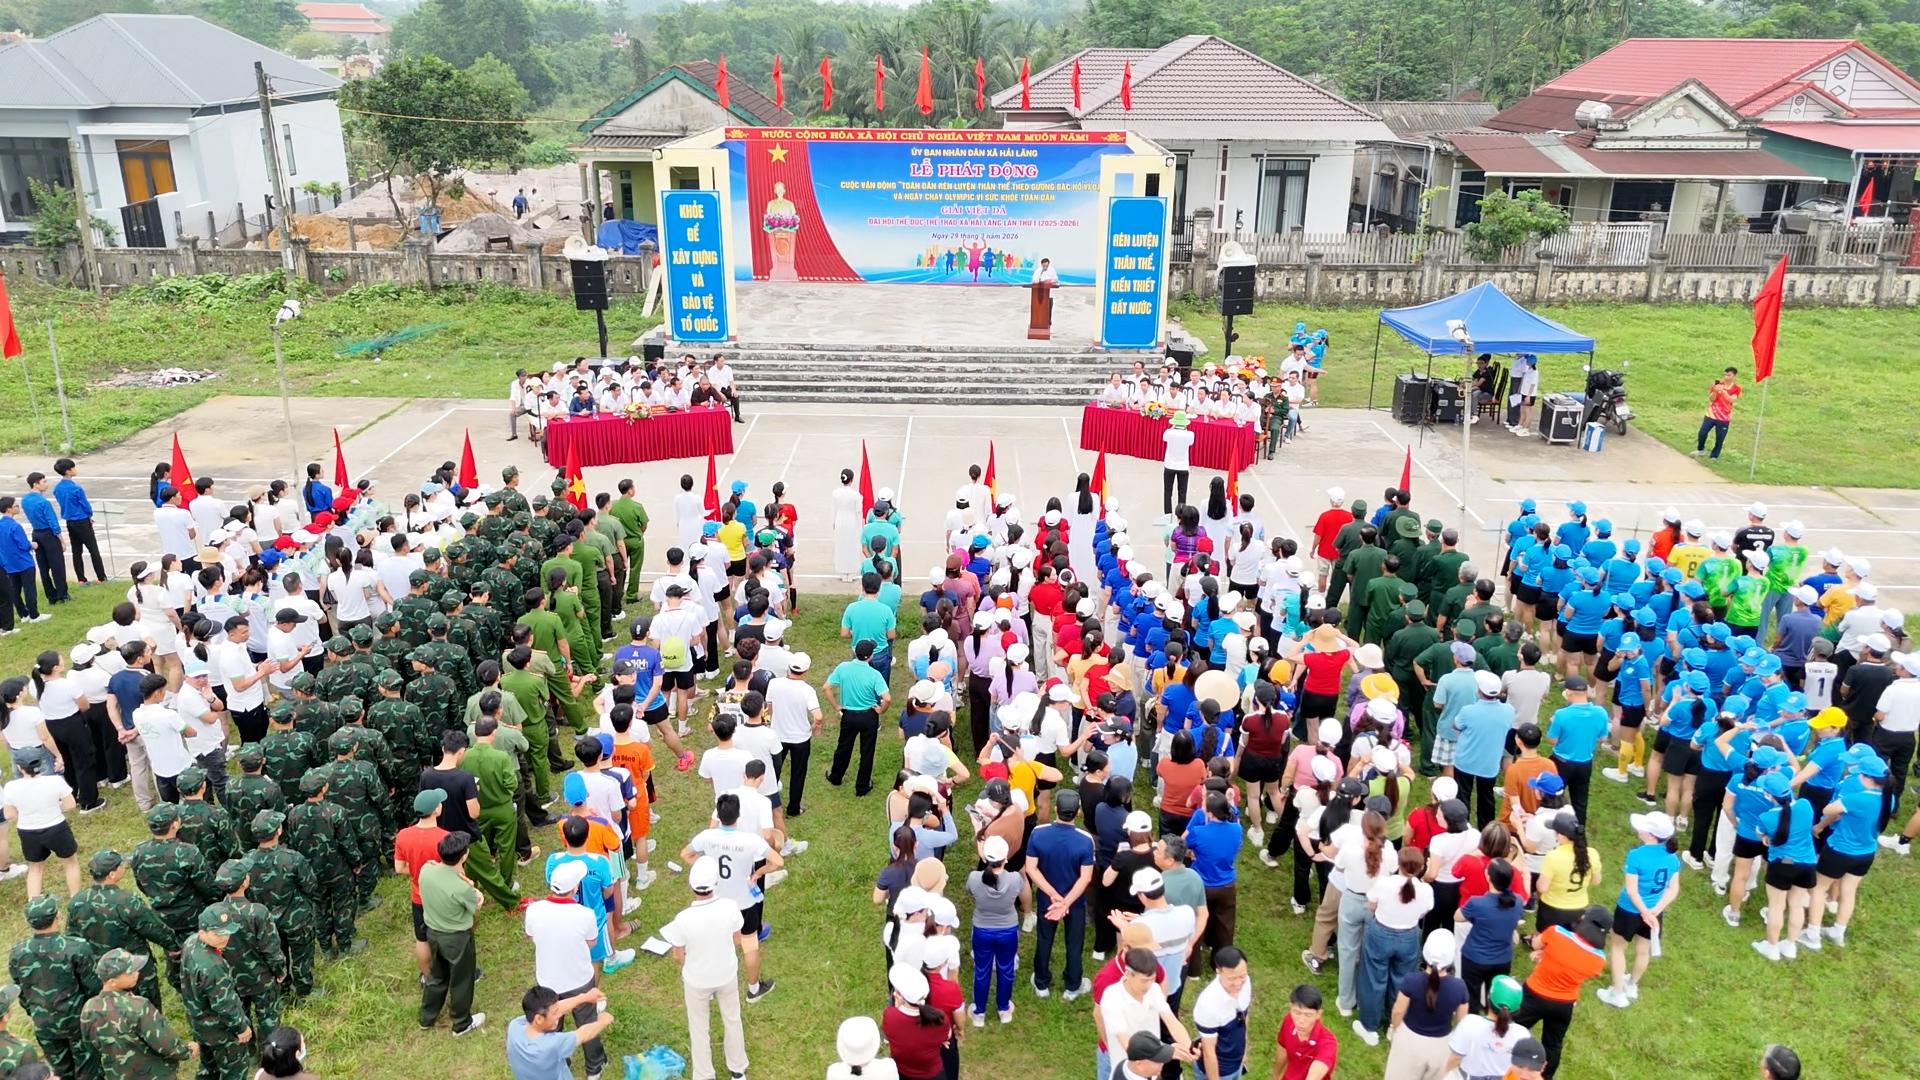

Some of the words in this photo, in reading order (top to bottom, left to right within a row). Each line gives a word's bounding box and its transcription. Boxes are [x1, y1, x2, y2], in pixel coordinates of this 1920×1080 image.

[760, 130, 792, 139] NƯỚC
[795, 130, 826, 140] CỘNG
[830, 131, 854, 140] HÒA
[857, 131, 874, 140] XÃ
[876, 131, 897, 141] HỘI
[901, 131, 924, 140] CHỦ
[928, 132, 964, 141] NGHĨA
[966, 132, 992, 142] VIỆT
[996, 133, 1021, 141] NAM
[1024, 132, 1057, 142] MUÔN
[1060, 133, 1088, 142] NĂM!
[911, 147, 922, 156] ỦY
[924, 148, 942, 156] BAN
[942, 148, 967, 157] NHÂN
[968, 148, 985, 157] DÂN
[986, 148, 998, 157] XÃ
[1000, 148, 1014, 157] HẢI
[1016, 148, 1037, 157] LĂNG
[910, 158, 934, 176] LỄ
[938, 160, 985, 177] PHÁT
[988, 161, 1038, 180] ĐỘNG
[840, 181, 859, 190] CUỘC
[1012, 183, 1029, 191] THEO
[679, 200, 704, 218] KHỎE
[1038, 218, 1079, 227] (2025-2026)
[687, 222, 700, 242] ĐỂ
[1113, 232, 1130, 247] RÈN
[1132, 232, 1159, 250] LUYỆN
[672, 248, 690, 264] XÂY
[692, 249, 718, 267] DỰNG
[1114, 254, 1135, 270] THÂN
[1138, 252, 1155, 272] THỂ,
[692, 271, 704, 287] VÀ
[1111, 276, 1130, 292] KIẾN
[1132, 276, 1155, 292] THIẾT
[682, 292, 700, 310] BẢO
[702, 293, 714, 312] VỆ
[1111, 298, 1127, 314] ĐẤT
[1128, 300, 1152, 315] NƯỚC
[681, 313, 693, 332] TỔ
[694, 314, 719, 332] QUỐC
[1818, 677, 1825, 697] 1
[719, 855, 732, 879] 6
[1650, 868, 1668, 894] 9
